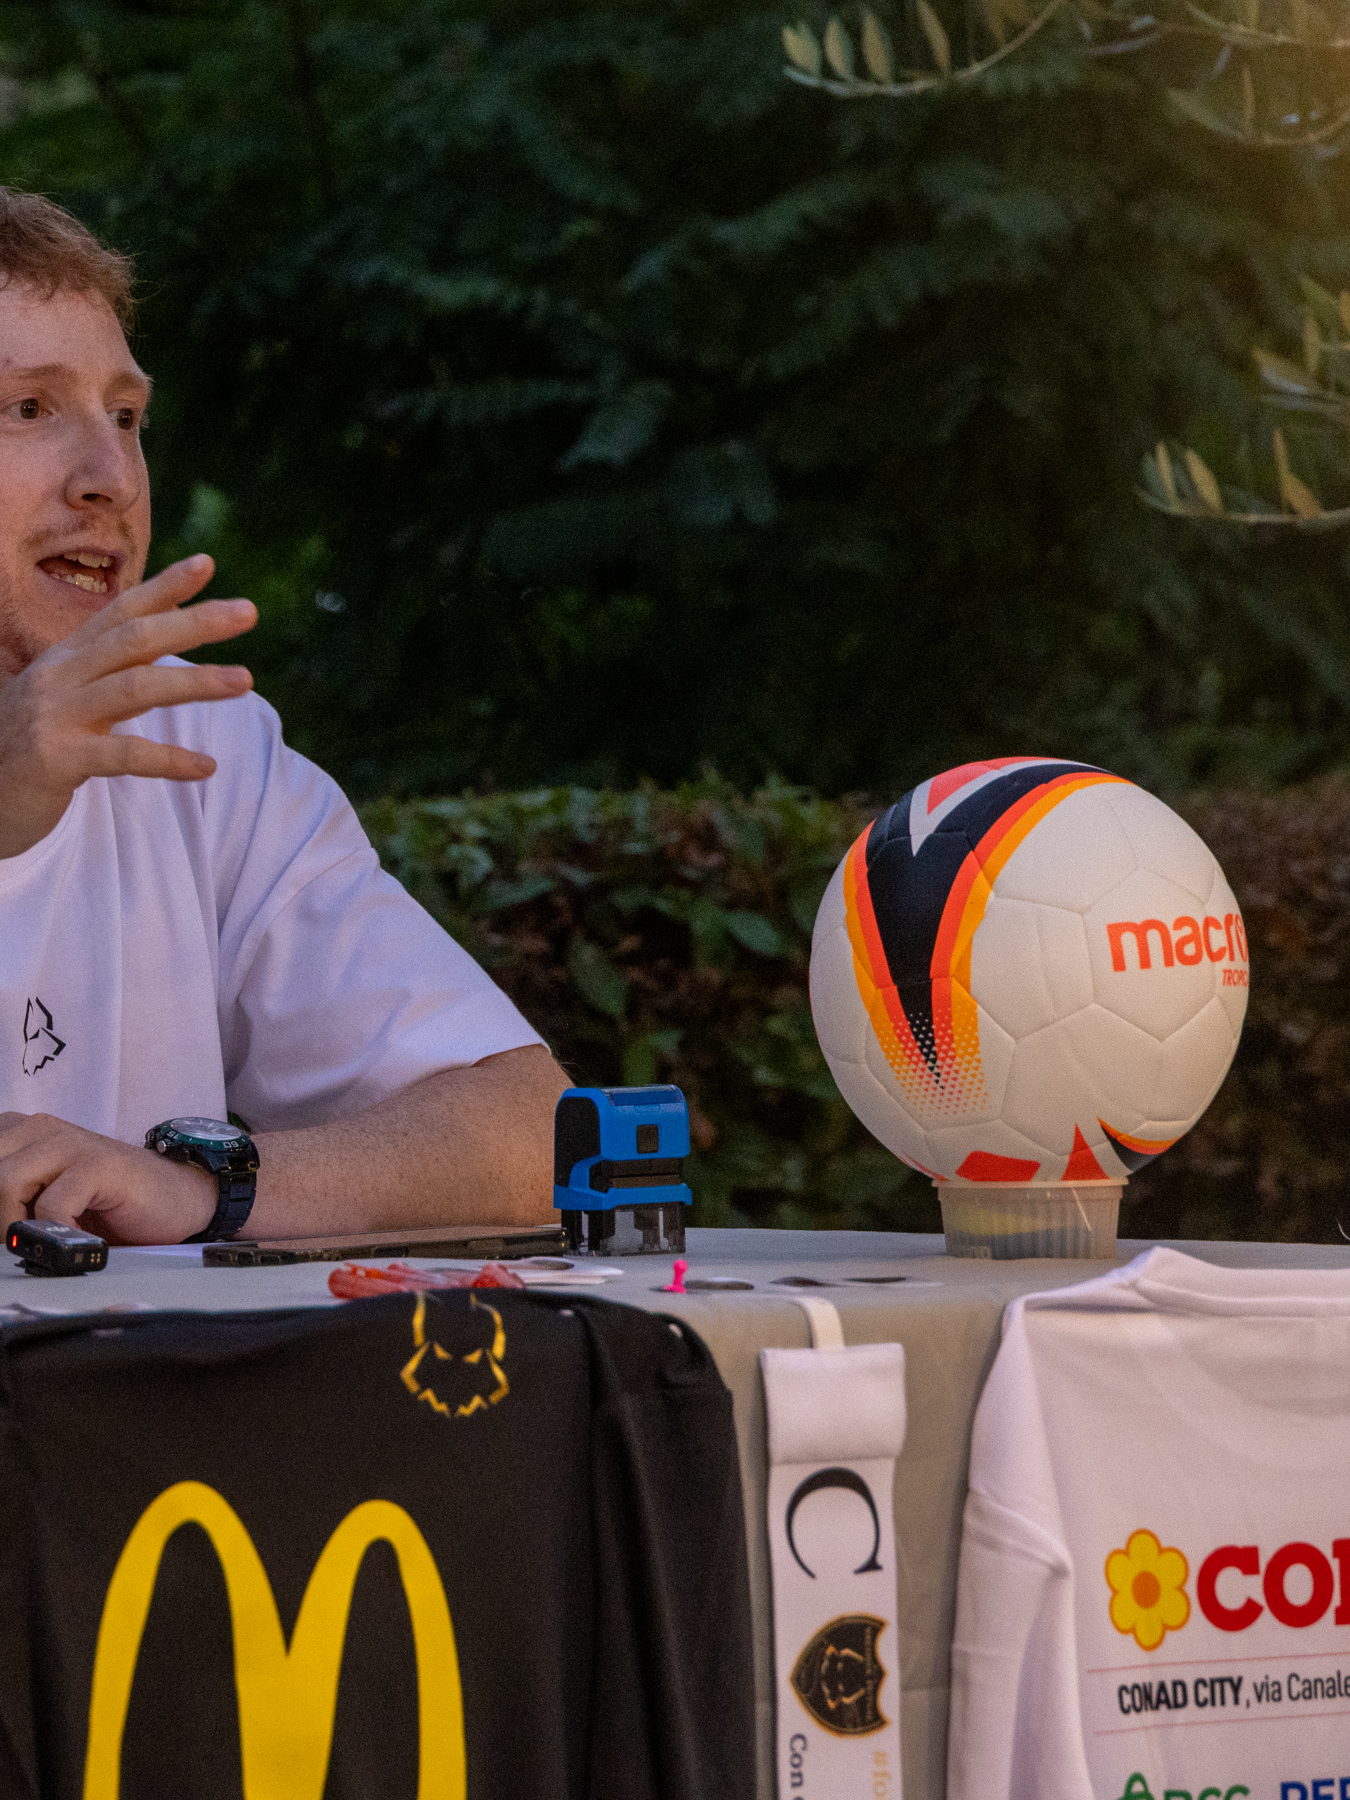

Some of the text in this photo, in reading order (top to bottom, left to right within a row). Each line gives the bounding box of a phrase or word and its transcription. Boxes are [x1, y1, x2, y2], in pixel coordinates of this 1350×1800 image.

[785, 1467, 883, 1579] C
[1196, 1538, 1350, 1633] CO
[1117, 1679, 1188, 1715] CONAD
[1193, 1675, 1250, 1709] CITY,
[1252, 1674, 1282, 1703] via
[789, 1733, 807, 1788] Con
[873, 1751, 891, 1800] #fo
